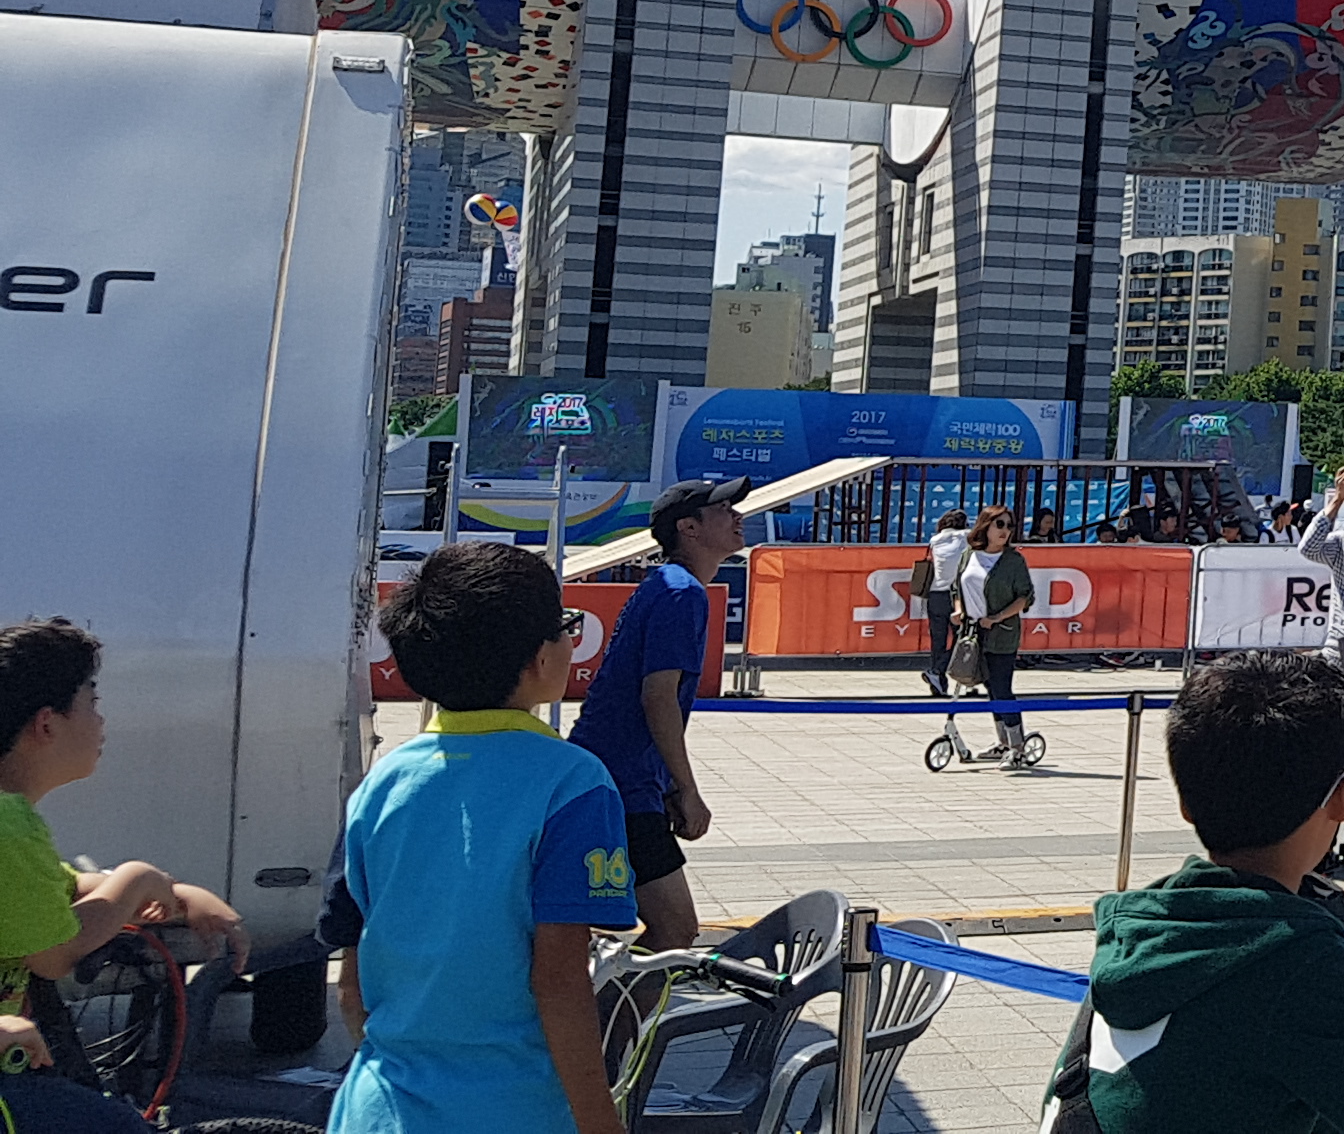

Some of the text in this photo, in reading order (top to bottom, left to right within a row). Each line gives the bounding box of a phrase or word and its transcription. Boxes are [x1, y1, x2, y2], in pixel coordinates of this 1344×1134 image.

[851, 410, 887, 423] 2017
[702, 428, 785, 444] 레저스포츠
[713, 447, 772, 463] 페스티벌
[584, 847, 630, 889] 16
